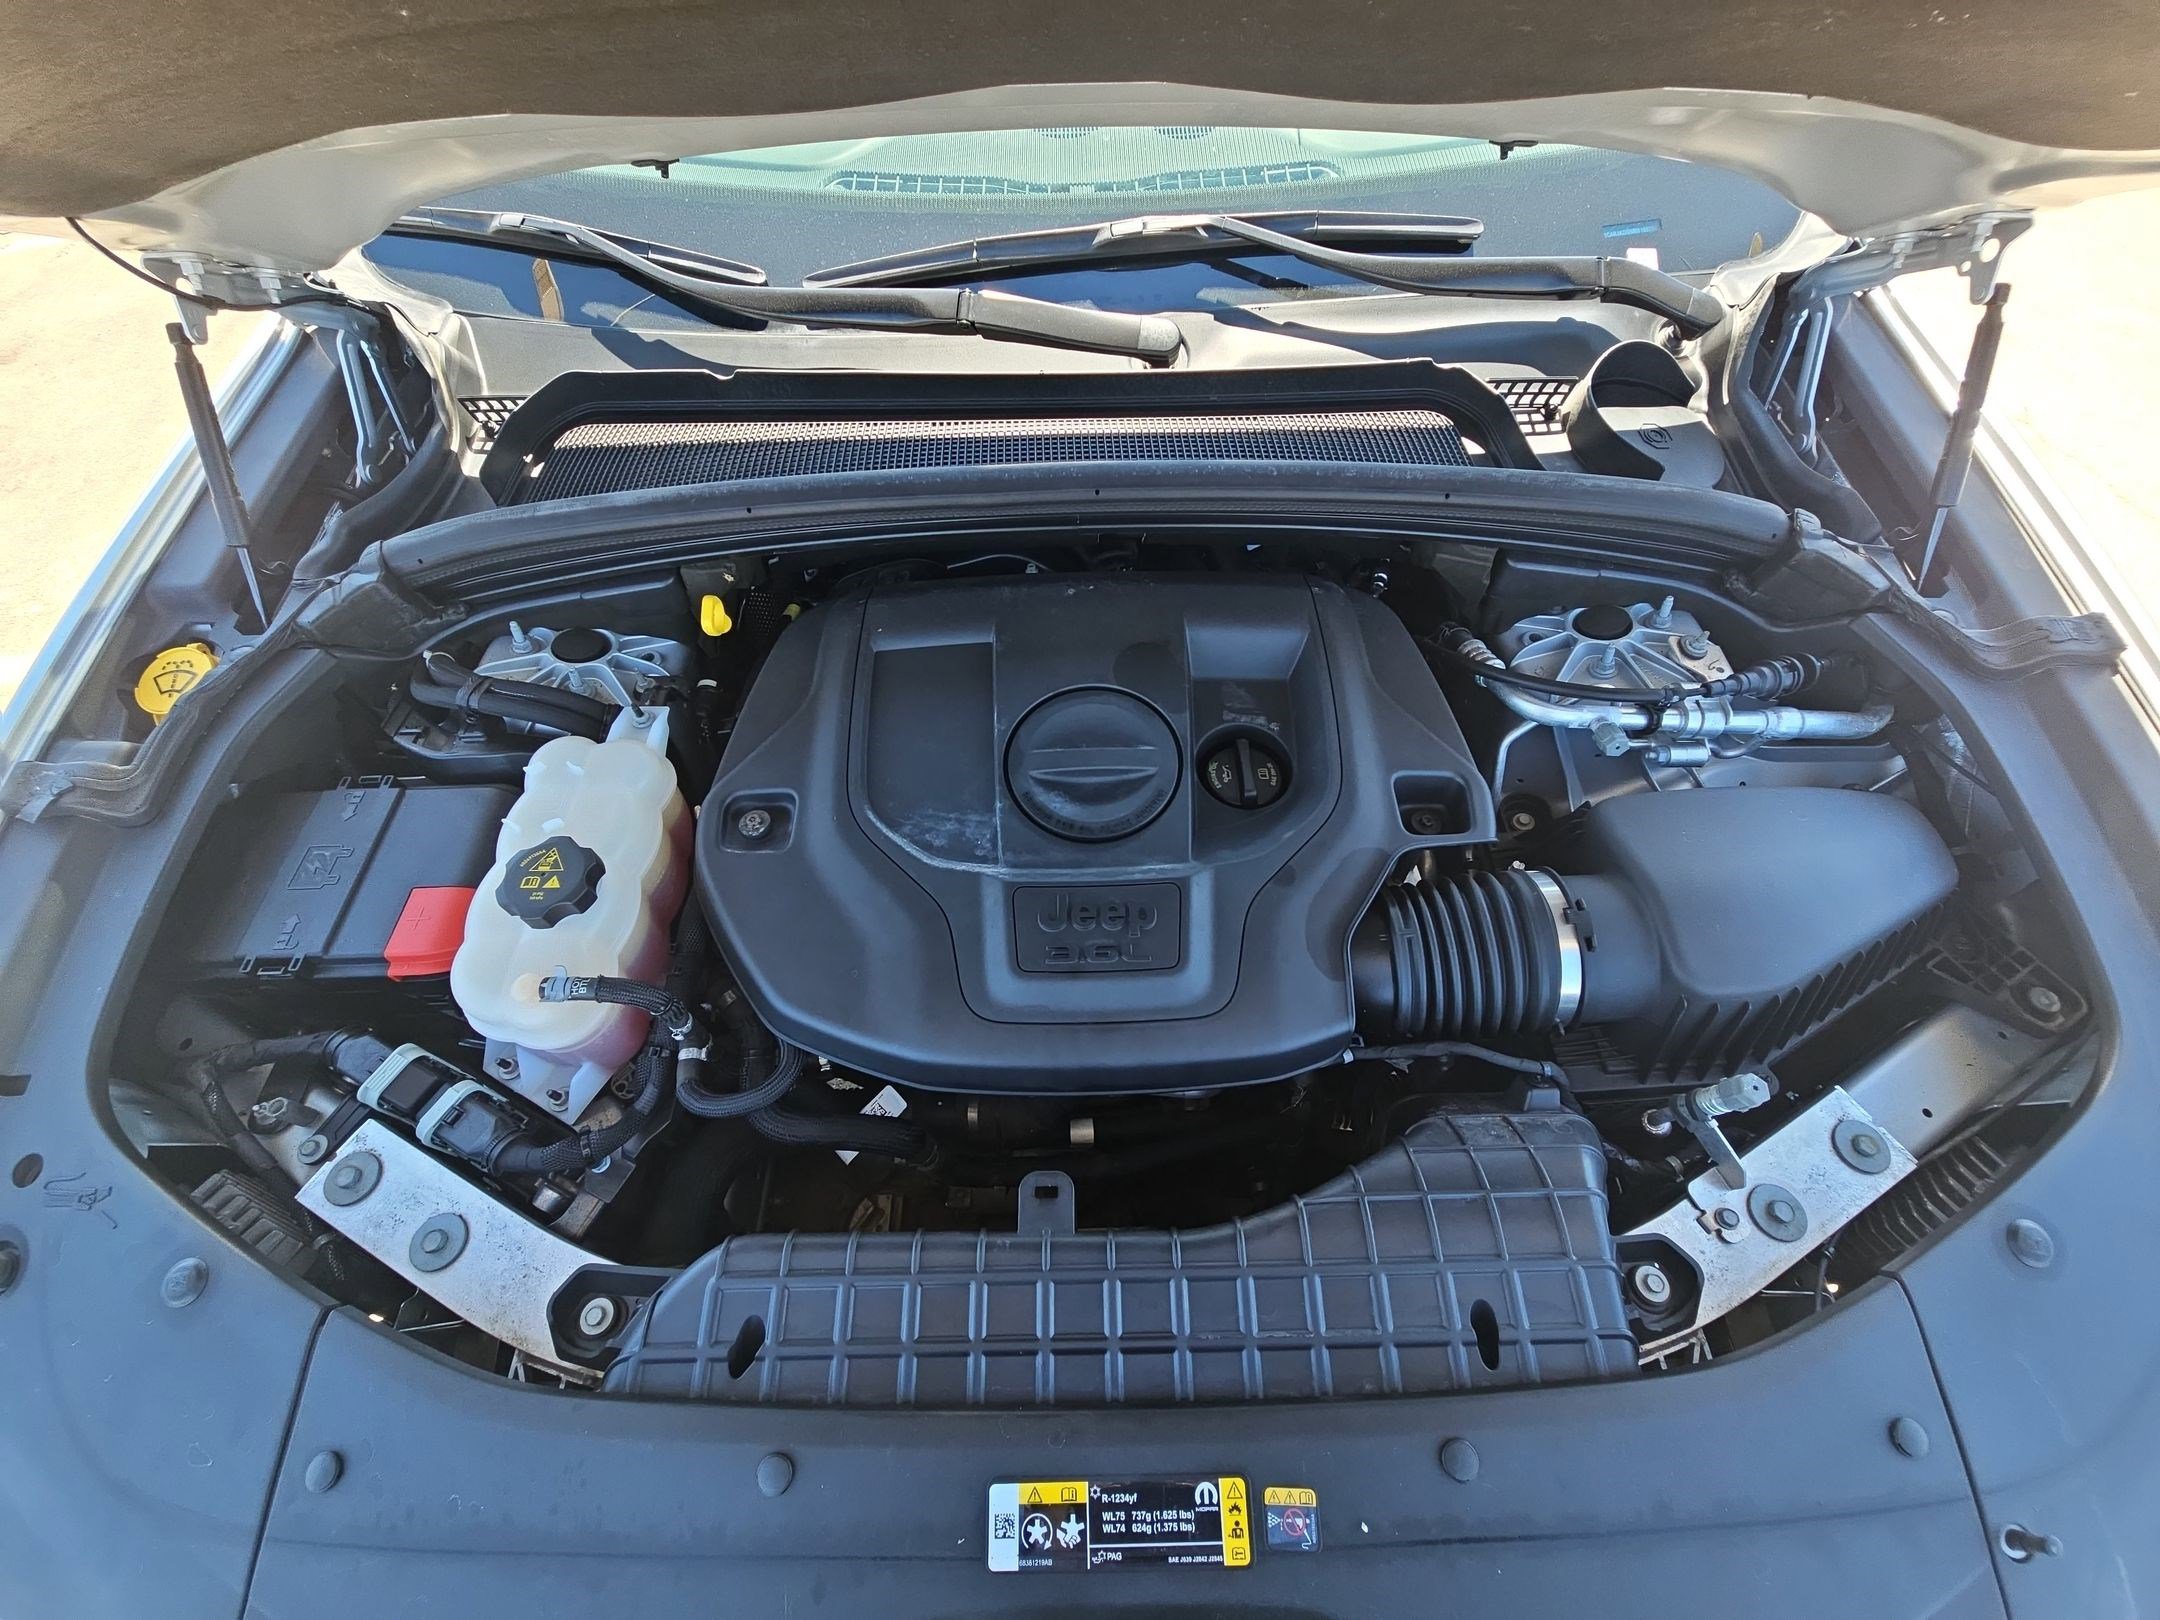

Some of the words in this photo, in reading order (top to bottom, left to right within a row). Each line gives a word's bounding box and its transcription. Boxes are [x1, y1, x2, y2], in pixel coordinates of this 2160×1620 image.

[1037, 892, 1158, 938] Jeep
[1044, 940, 1152, 964] 3.6L
[1101, 1492, 1138, 1504] R-1234yf
[1102, 1511, 1126, 1521] WL75
[1131, 1510, 1152, 1522] 737g
[1153, 1510, 1178, 1521] (1.625
[1179, 1509, 1195, 1521] lbs)
[1102, 1523, 1126, 1533] WL74
[1132, 1523, 1152, 1534] 624g
[1153, 1522, 1178, 1534] (1.375
[1180, 1522, 1196, 1533] lbs)
[1107, 1552, 1122, 1561] PAG
